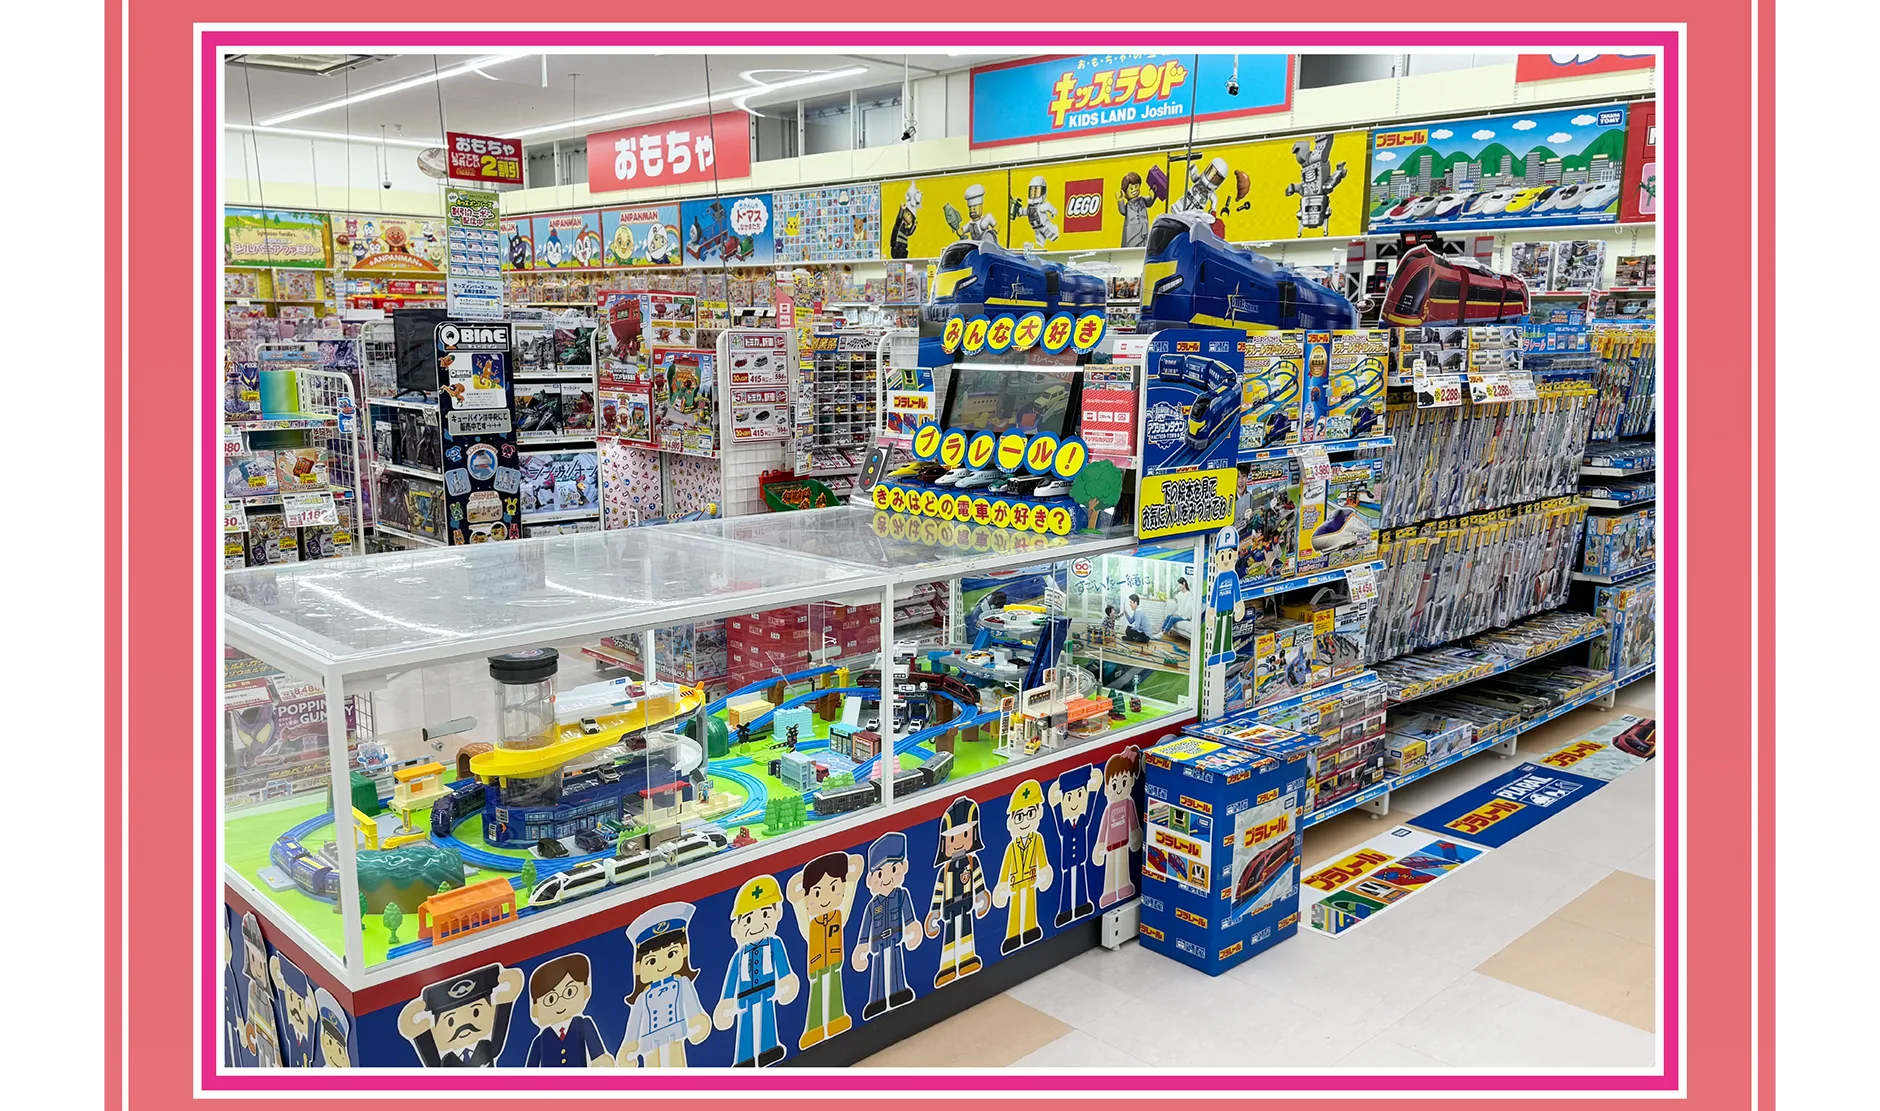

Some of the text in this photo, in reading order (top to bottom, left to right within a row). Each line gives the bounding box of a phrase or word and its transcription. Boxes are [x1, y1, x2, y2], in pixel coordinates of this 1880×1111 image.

[1050, 59, 1188, 128] キッズランド
[1069, 101, 1184, 128] KIDS LAND Joshin
[1599, 112, 1621, 120] TAKARA
[1600, 117, 1621, 125] TOMY
[456, 137, 515, 156] おもちゃ
[1376, 131, 1427, 148] プラレール
[615, 130, 714, 180] おもちゃ
[481, 155, 520, 179] 2割引
[1067, 195, 1101, 217] LEGO
[549, 218, 582, 228] ANPANMAN
[620, 210, 658, 222] ANPANMAN
[737, 209, 762, 223] トーマス
[234, 243, 320, 257] シルバニアファミリー
[372, 254, 420, 267] ANPANMAN
[945, 319, 1098, 346] みんな大好き
[893, 395, 929, 409] プラレール
[876, 488, 1066, 530] きみはどの電車が好き?
[1225, 532, 1231, 543] P
[1542, 741, 1604, 768] プラレール
[1181, 796, 1211, 813] プラレール
[1257, 789, 1278, 804] プラレール
[1451, 799, 1523, 834] プラレール
[1244, 816, 1288, 847] プラレール
[1156, 831, 1200, 858] プラレール
[1302, 851, 1388, 892] プラレール
[1176, 909, 1207, 927] プラレール
[828, 924, 840, 938] P
[1219, 941, 1243, 960] プラレール
